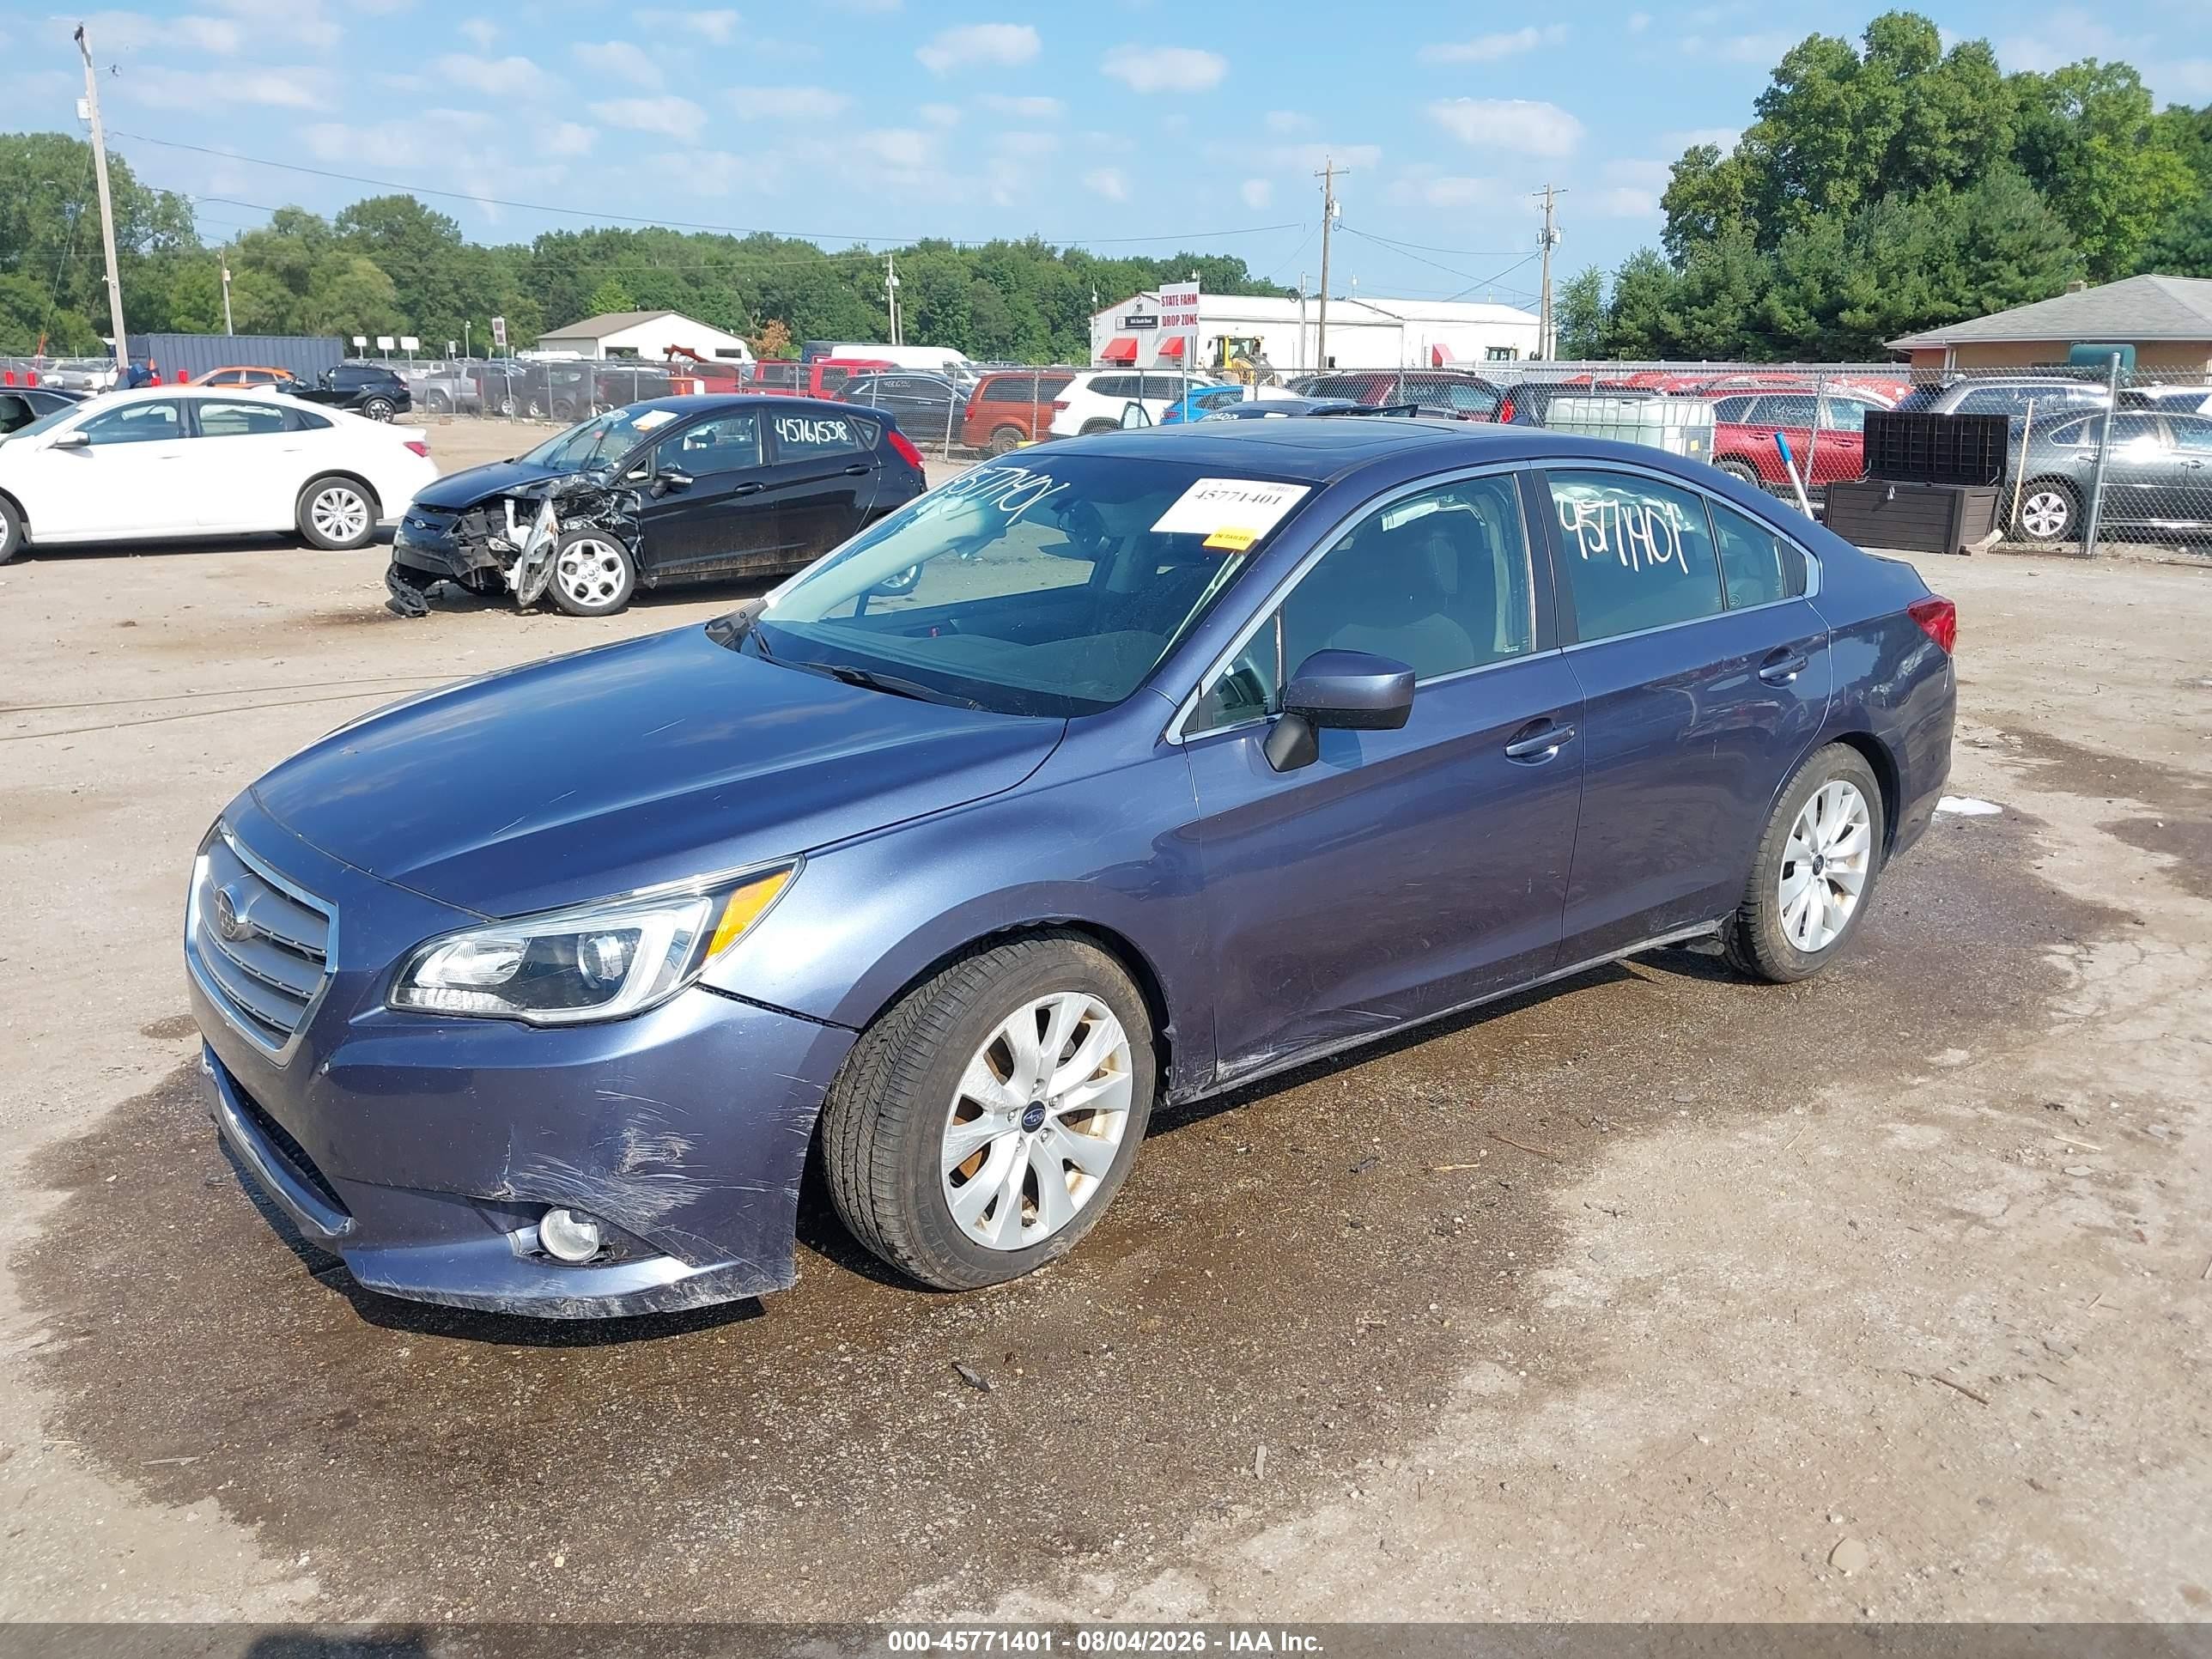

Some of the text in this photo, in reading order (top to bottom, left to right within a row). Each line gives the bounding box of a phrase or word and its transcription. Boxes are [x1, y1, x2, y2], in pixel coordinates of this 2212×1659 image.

[1161, 293, 1198, 307] STATE FARM
[1162, 313, 1198, 327] DROP ZONE
[775, 418, 848, 445] 45761538
[1194, 489, 1283, 506] 45771401
